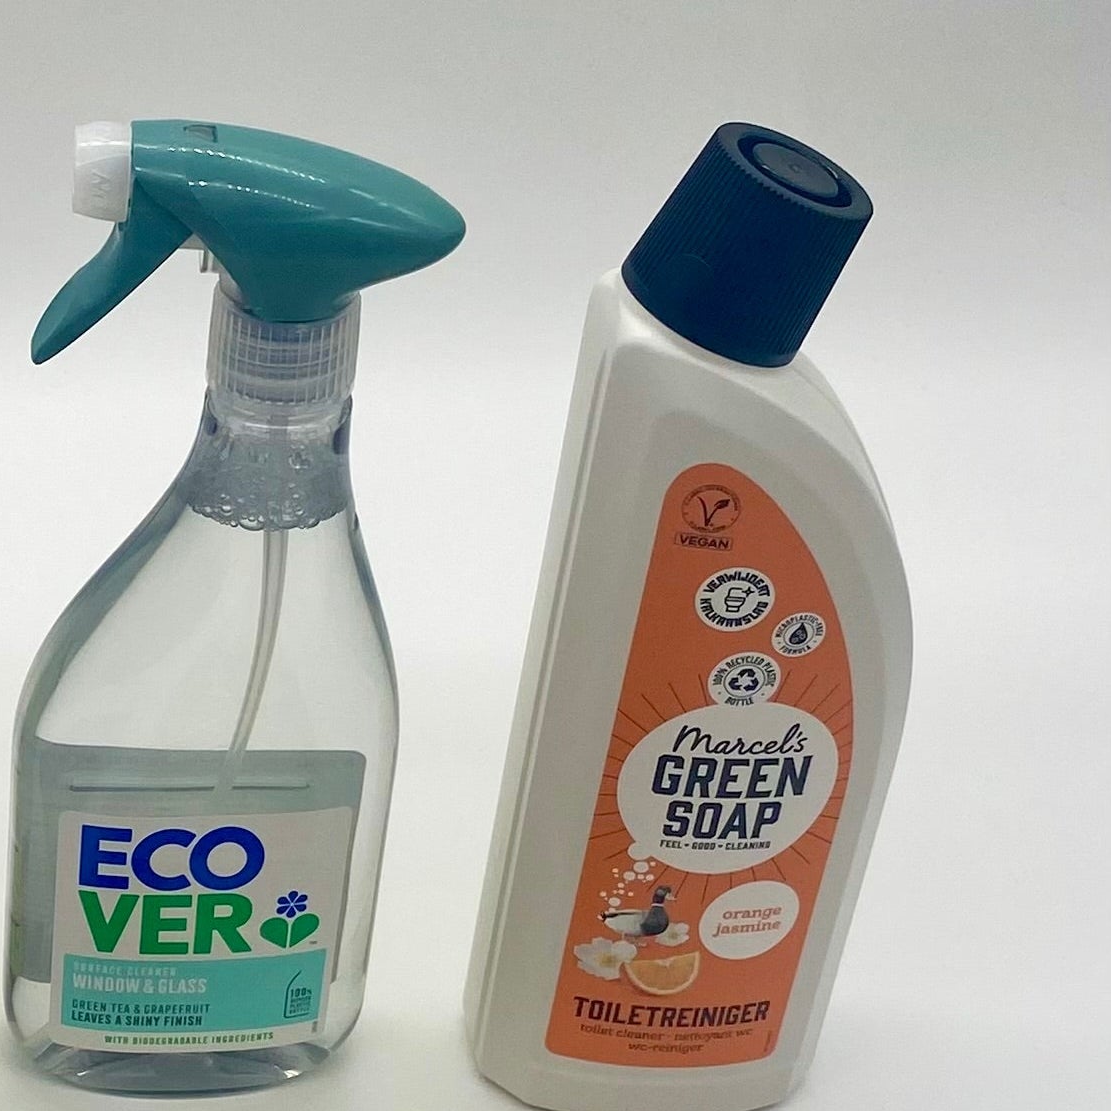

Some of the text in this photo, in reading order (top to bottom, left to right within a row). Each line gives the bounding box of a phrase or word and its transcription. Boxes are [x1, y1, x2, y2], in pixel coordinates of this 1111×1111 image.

[679, 534, 730, 549] VEGAN
[703, 571, 771, 598] VERWIJDERT
[726, 655, 765, 671] RECYCLED
[724, 697, 755, 707] BOTTLE
[672, 723, 808, 756] Marcel's
[651, 754, 814, 799] GREEN
[663, 800, 783, 840] SOAP
[659, 839, 771, 850] FEEL GOOD CLEANING
[78, 823, 266, 891] ECO
[78, 890, 253, 955] VER
[722, 906, 782, 922] orange
[712, 919, 781, 938] jasmine
[73, 973, 207, 995] WINDOW & GLASS
[72, 998, 210, 1014] GREEN TEA & GRAPEFRUIT
[573, 996, 771, 1028] TOILETREINIGER
[71, 1009, 203, 1026] LEAVES A SHINY FINISH
[104, 1035, 129, 1045] WITH
[212, 1032, 274, 1043] INGREDIENTS
[580, 1023, 614, 1036] toilet
[615, 1028, 663, 1041] cleaner
